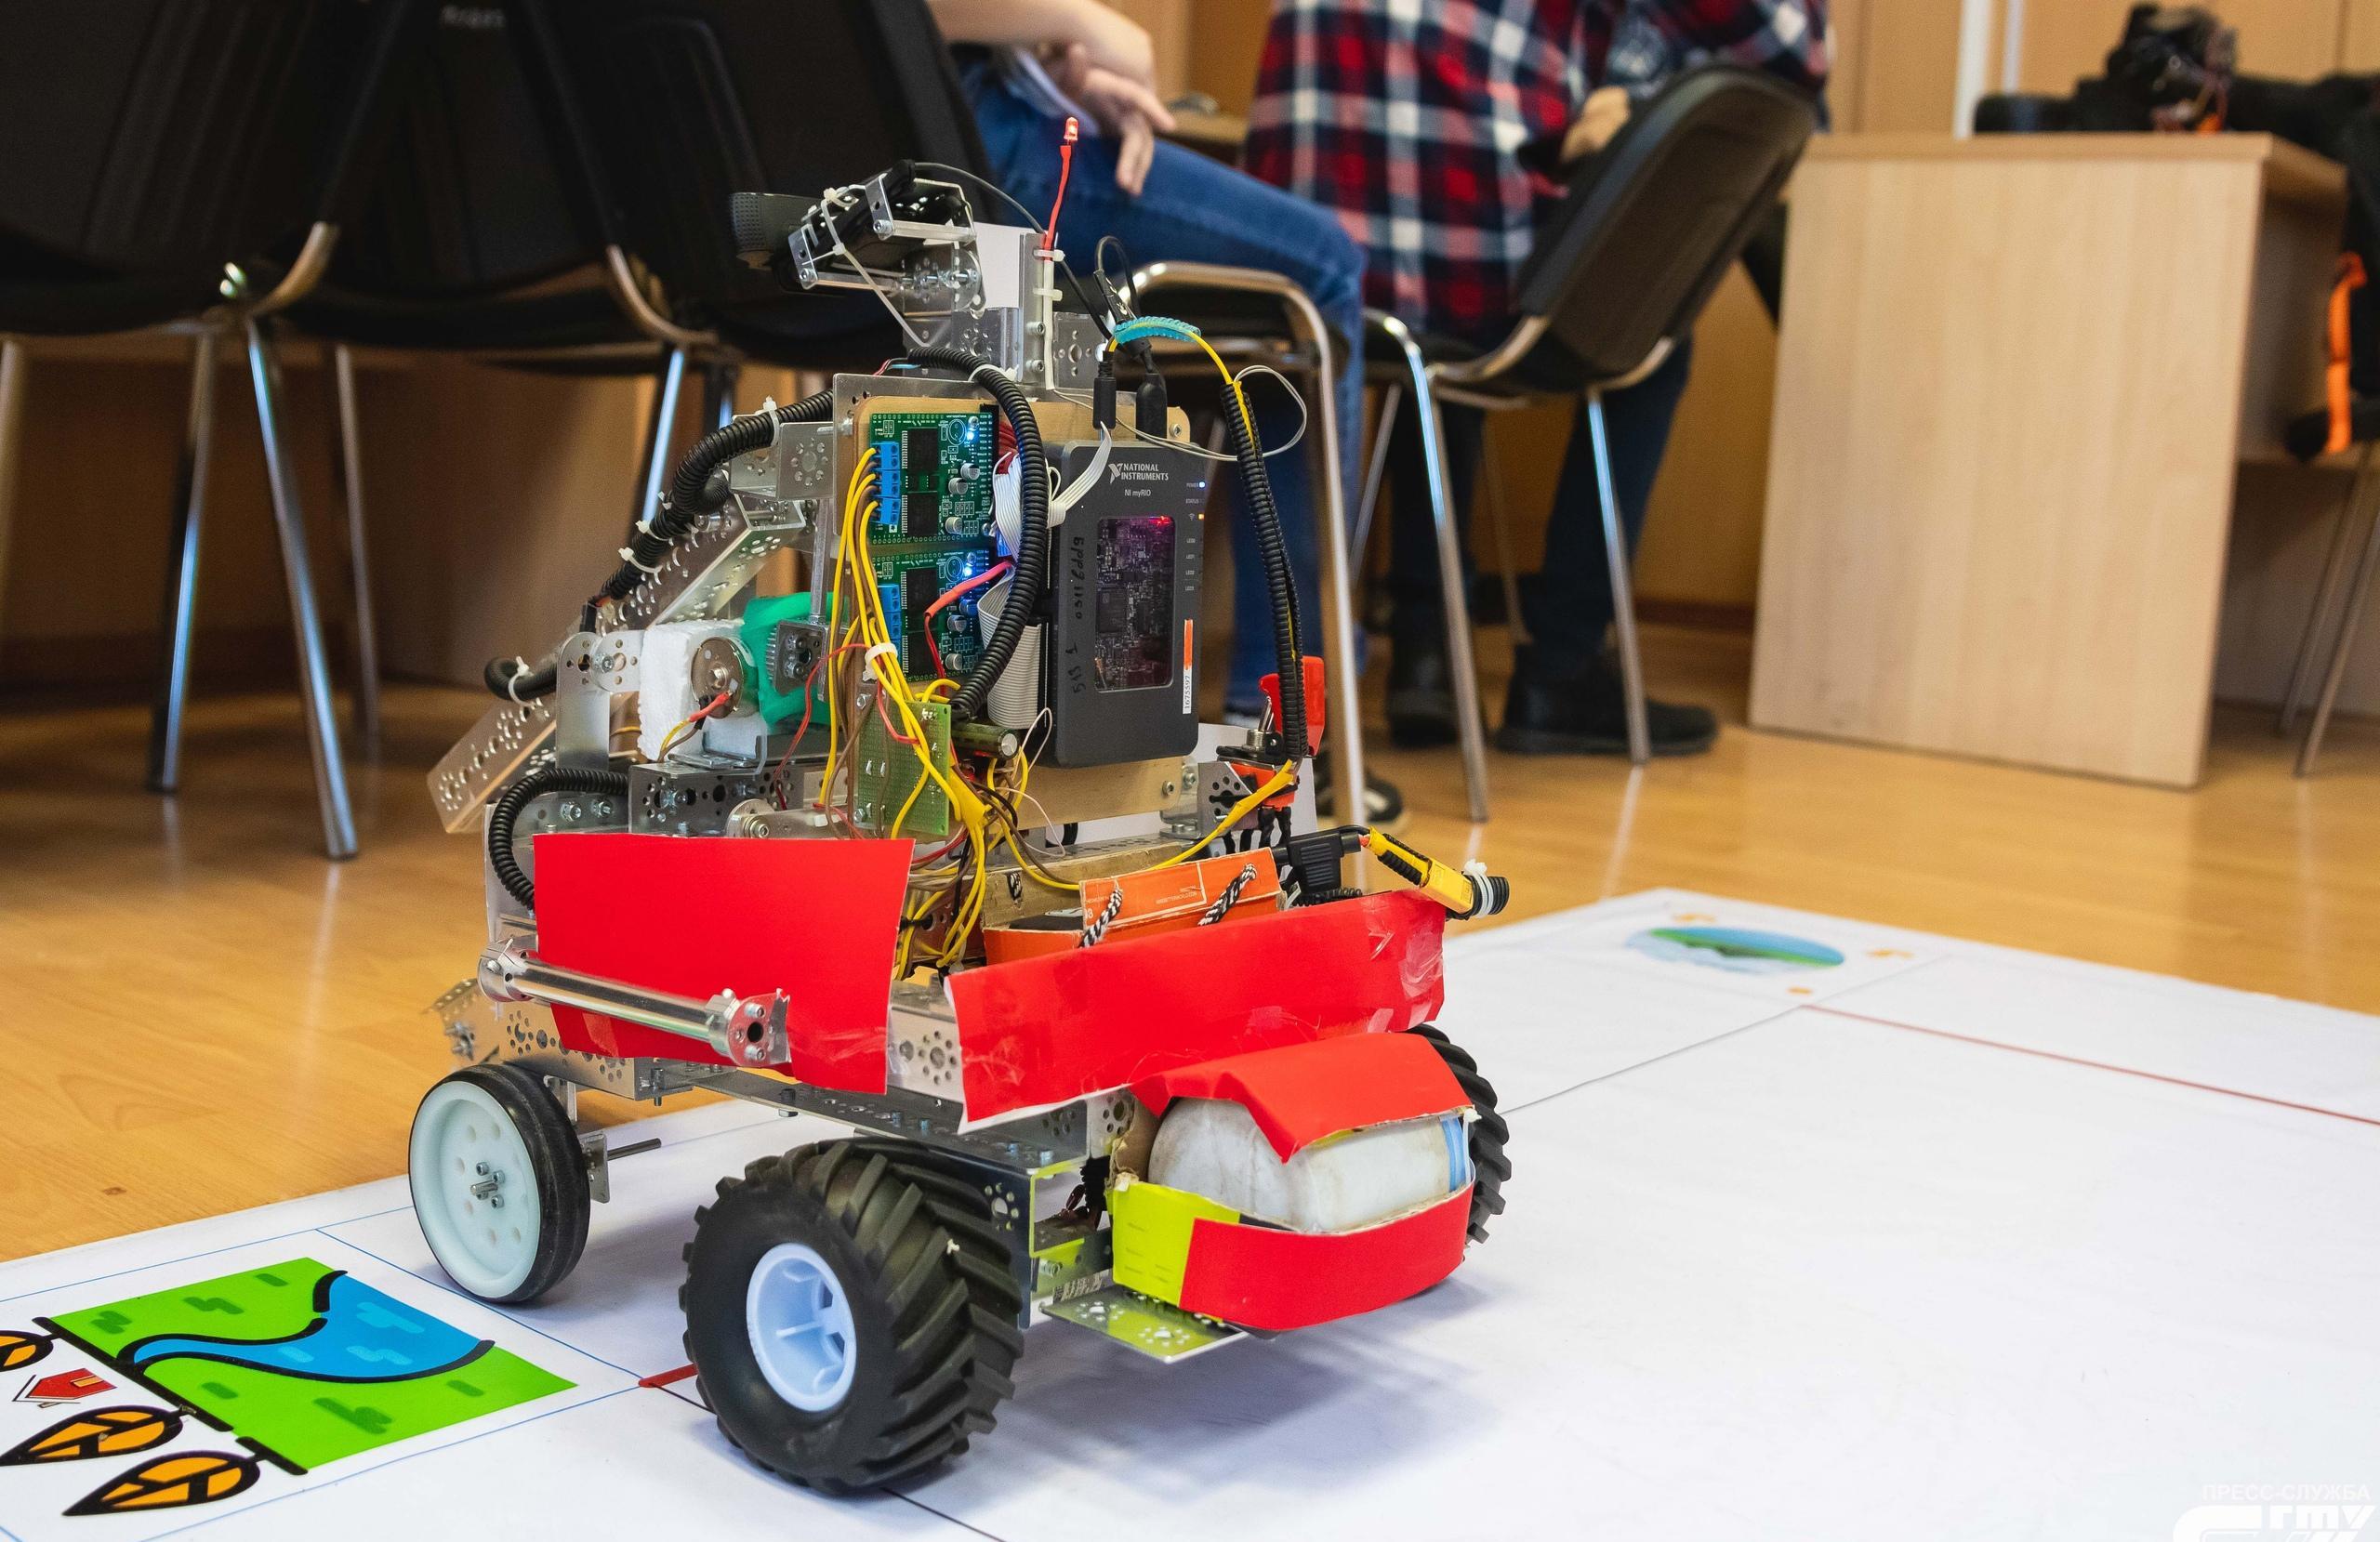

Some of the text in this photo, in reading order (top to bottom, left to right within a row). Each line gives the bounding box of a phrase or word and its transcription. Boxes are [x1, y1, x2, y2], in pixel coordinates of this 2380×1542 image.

[1123, 463, 1159, 472] NATIONAL
[1120, 472, 1169, 481] INSTRUMENTS
[1132, 489, 1152, 498] myRIO
